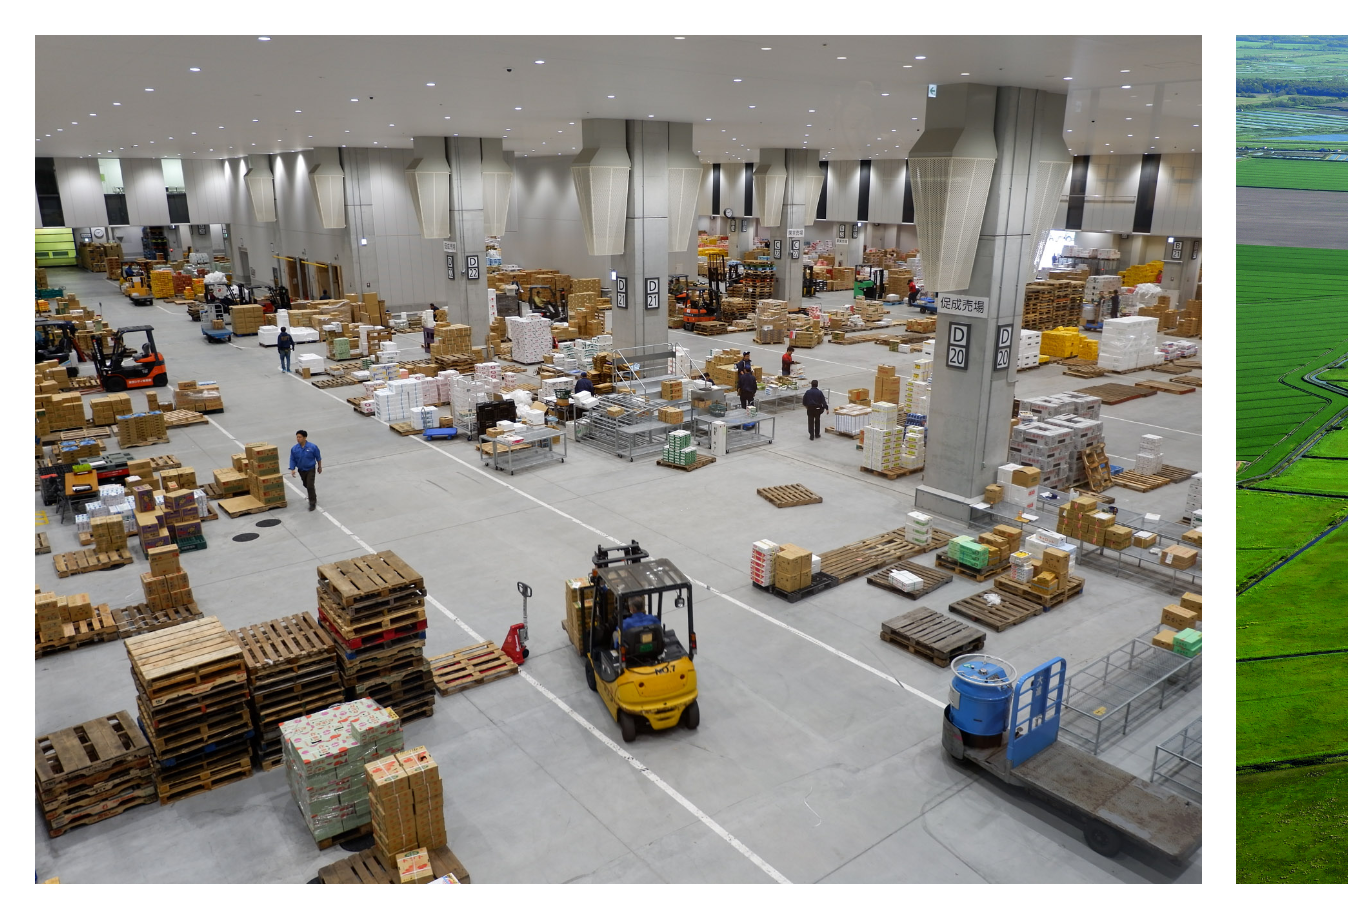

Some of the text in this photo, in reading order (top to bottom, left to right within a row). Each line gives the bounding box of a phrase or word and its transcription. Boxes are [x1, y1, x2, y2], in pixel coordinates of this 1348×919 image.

[469, 257, 477, 266] D
[469, 268, 478, 278] 22
[619, 279, 625, 291] D
[649, 280, 657, 291] D
[618, 294, 625, 306] 21
[648, 295, 657, 307] 21
[940, 296, 985, 314] 促成売場
[953, 326, 965, 342] D
[1001, 328, 1010, 345] D
[949, 347, 965, 365] 20
[997, 349, 1009, 367] 20
